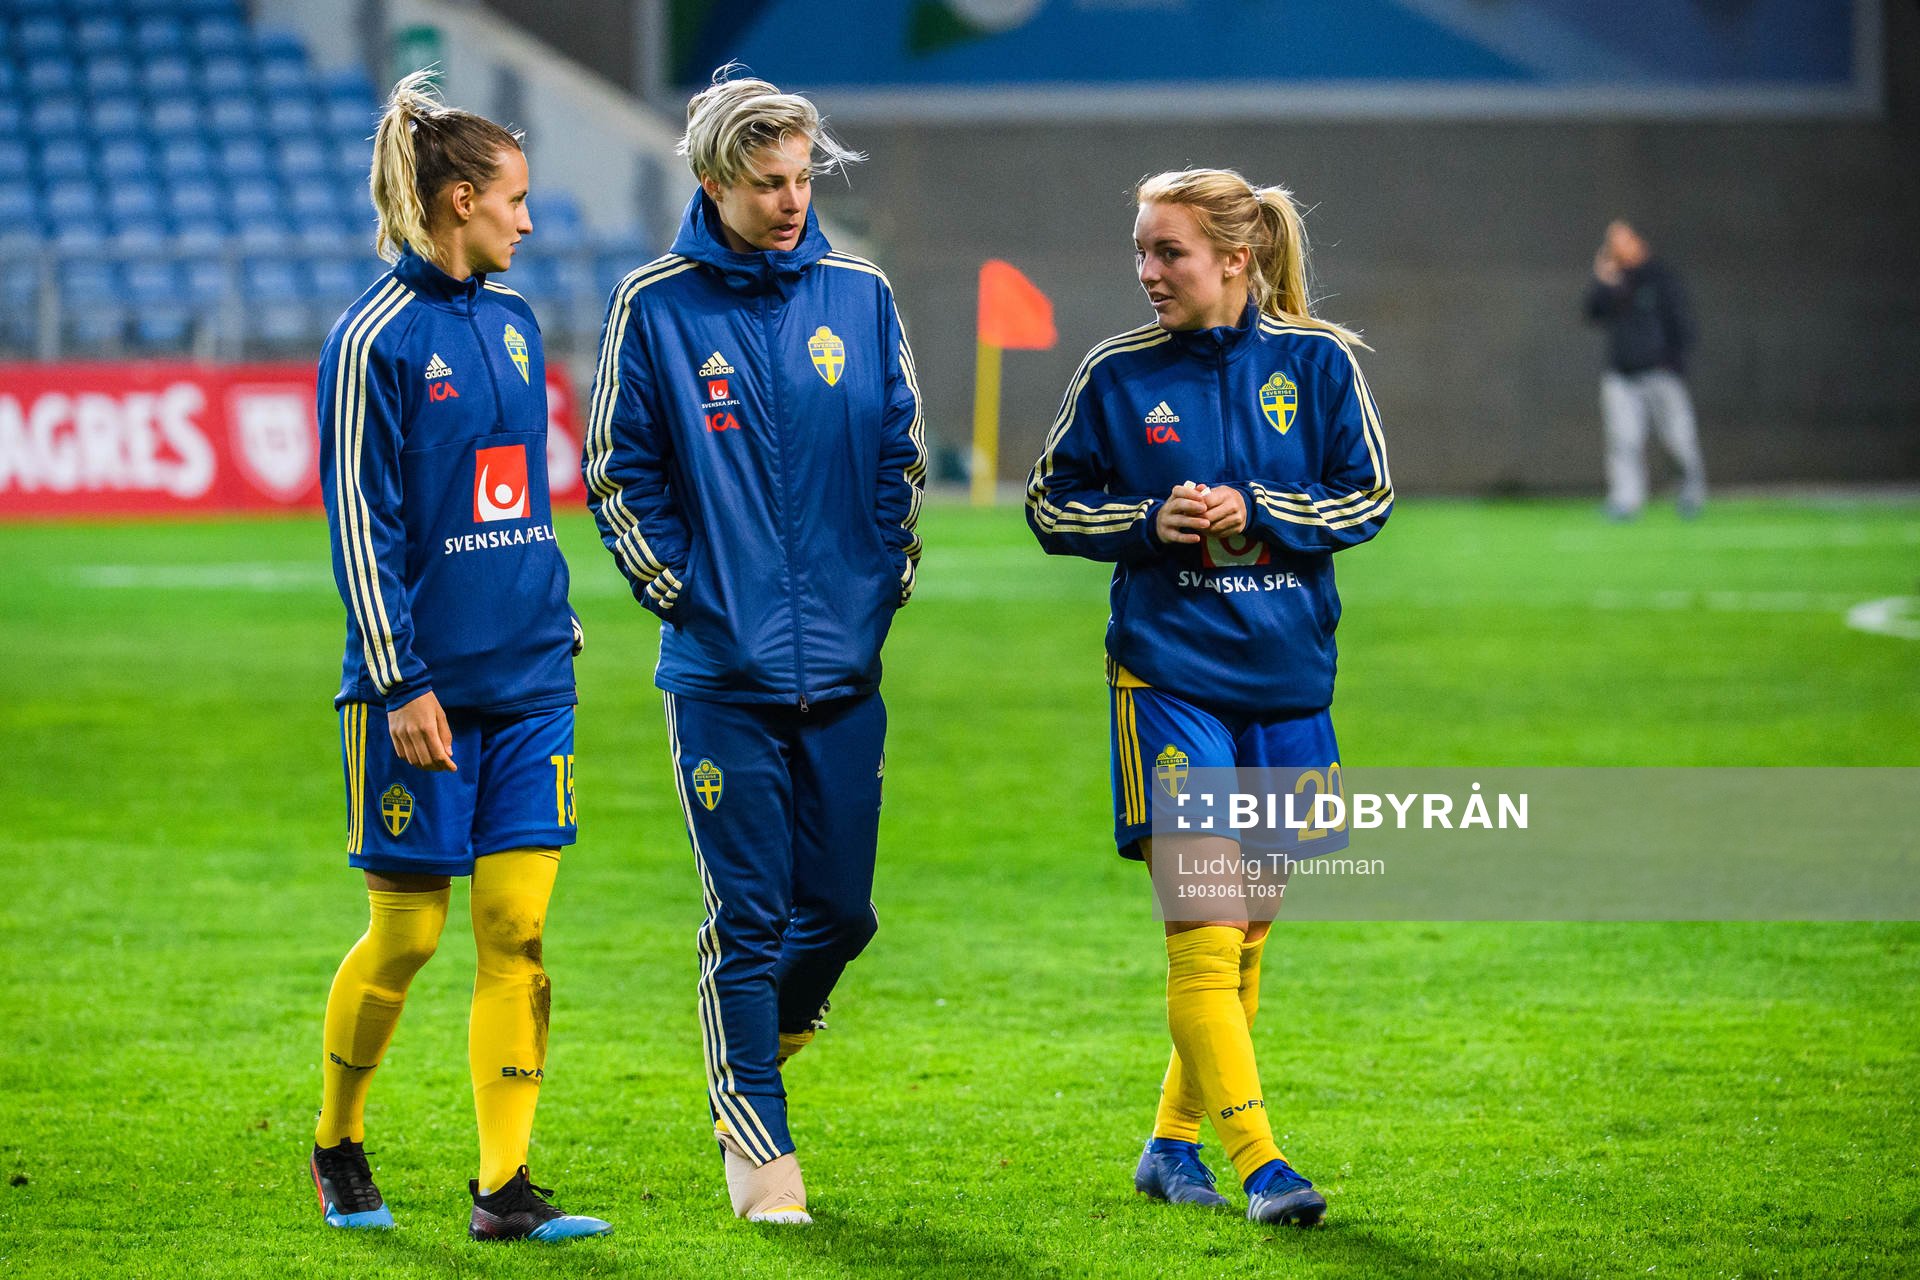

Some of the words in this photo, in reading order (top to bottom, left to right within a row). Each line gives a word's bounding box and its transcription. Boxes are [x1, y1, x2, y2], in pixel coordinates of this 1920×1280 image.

[425, 367, 452, 379] adidas
[699, 366, 734, 376] adidas
[429, 381, 460, 403] ICA
[705, 412, 741, 433] ICA
[1144, 415, 1180, 424] adidas
[1146, 425, 1181, 445] ICA
[444, 529, 525, 555] SVENSKA
[550, 754, 577, 828] 15
[1294, 761, 1346, 842] 20
